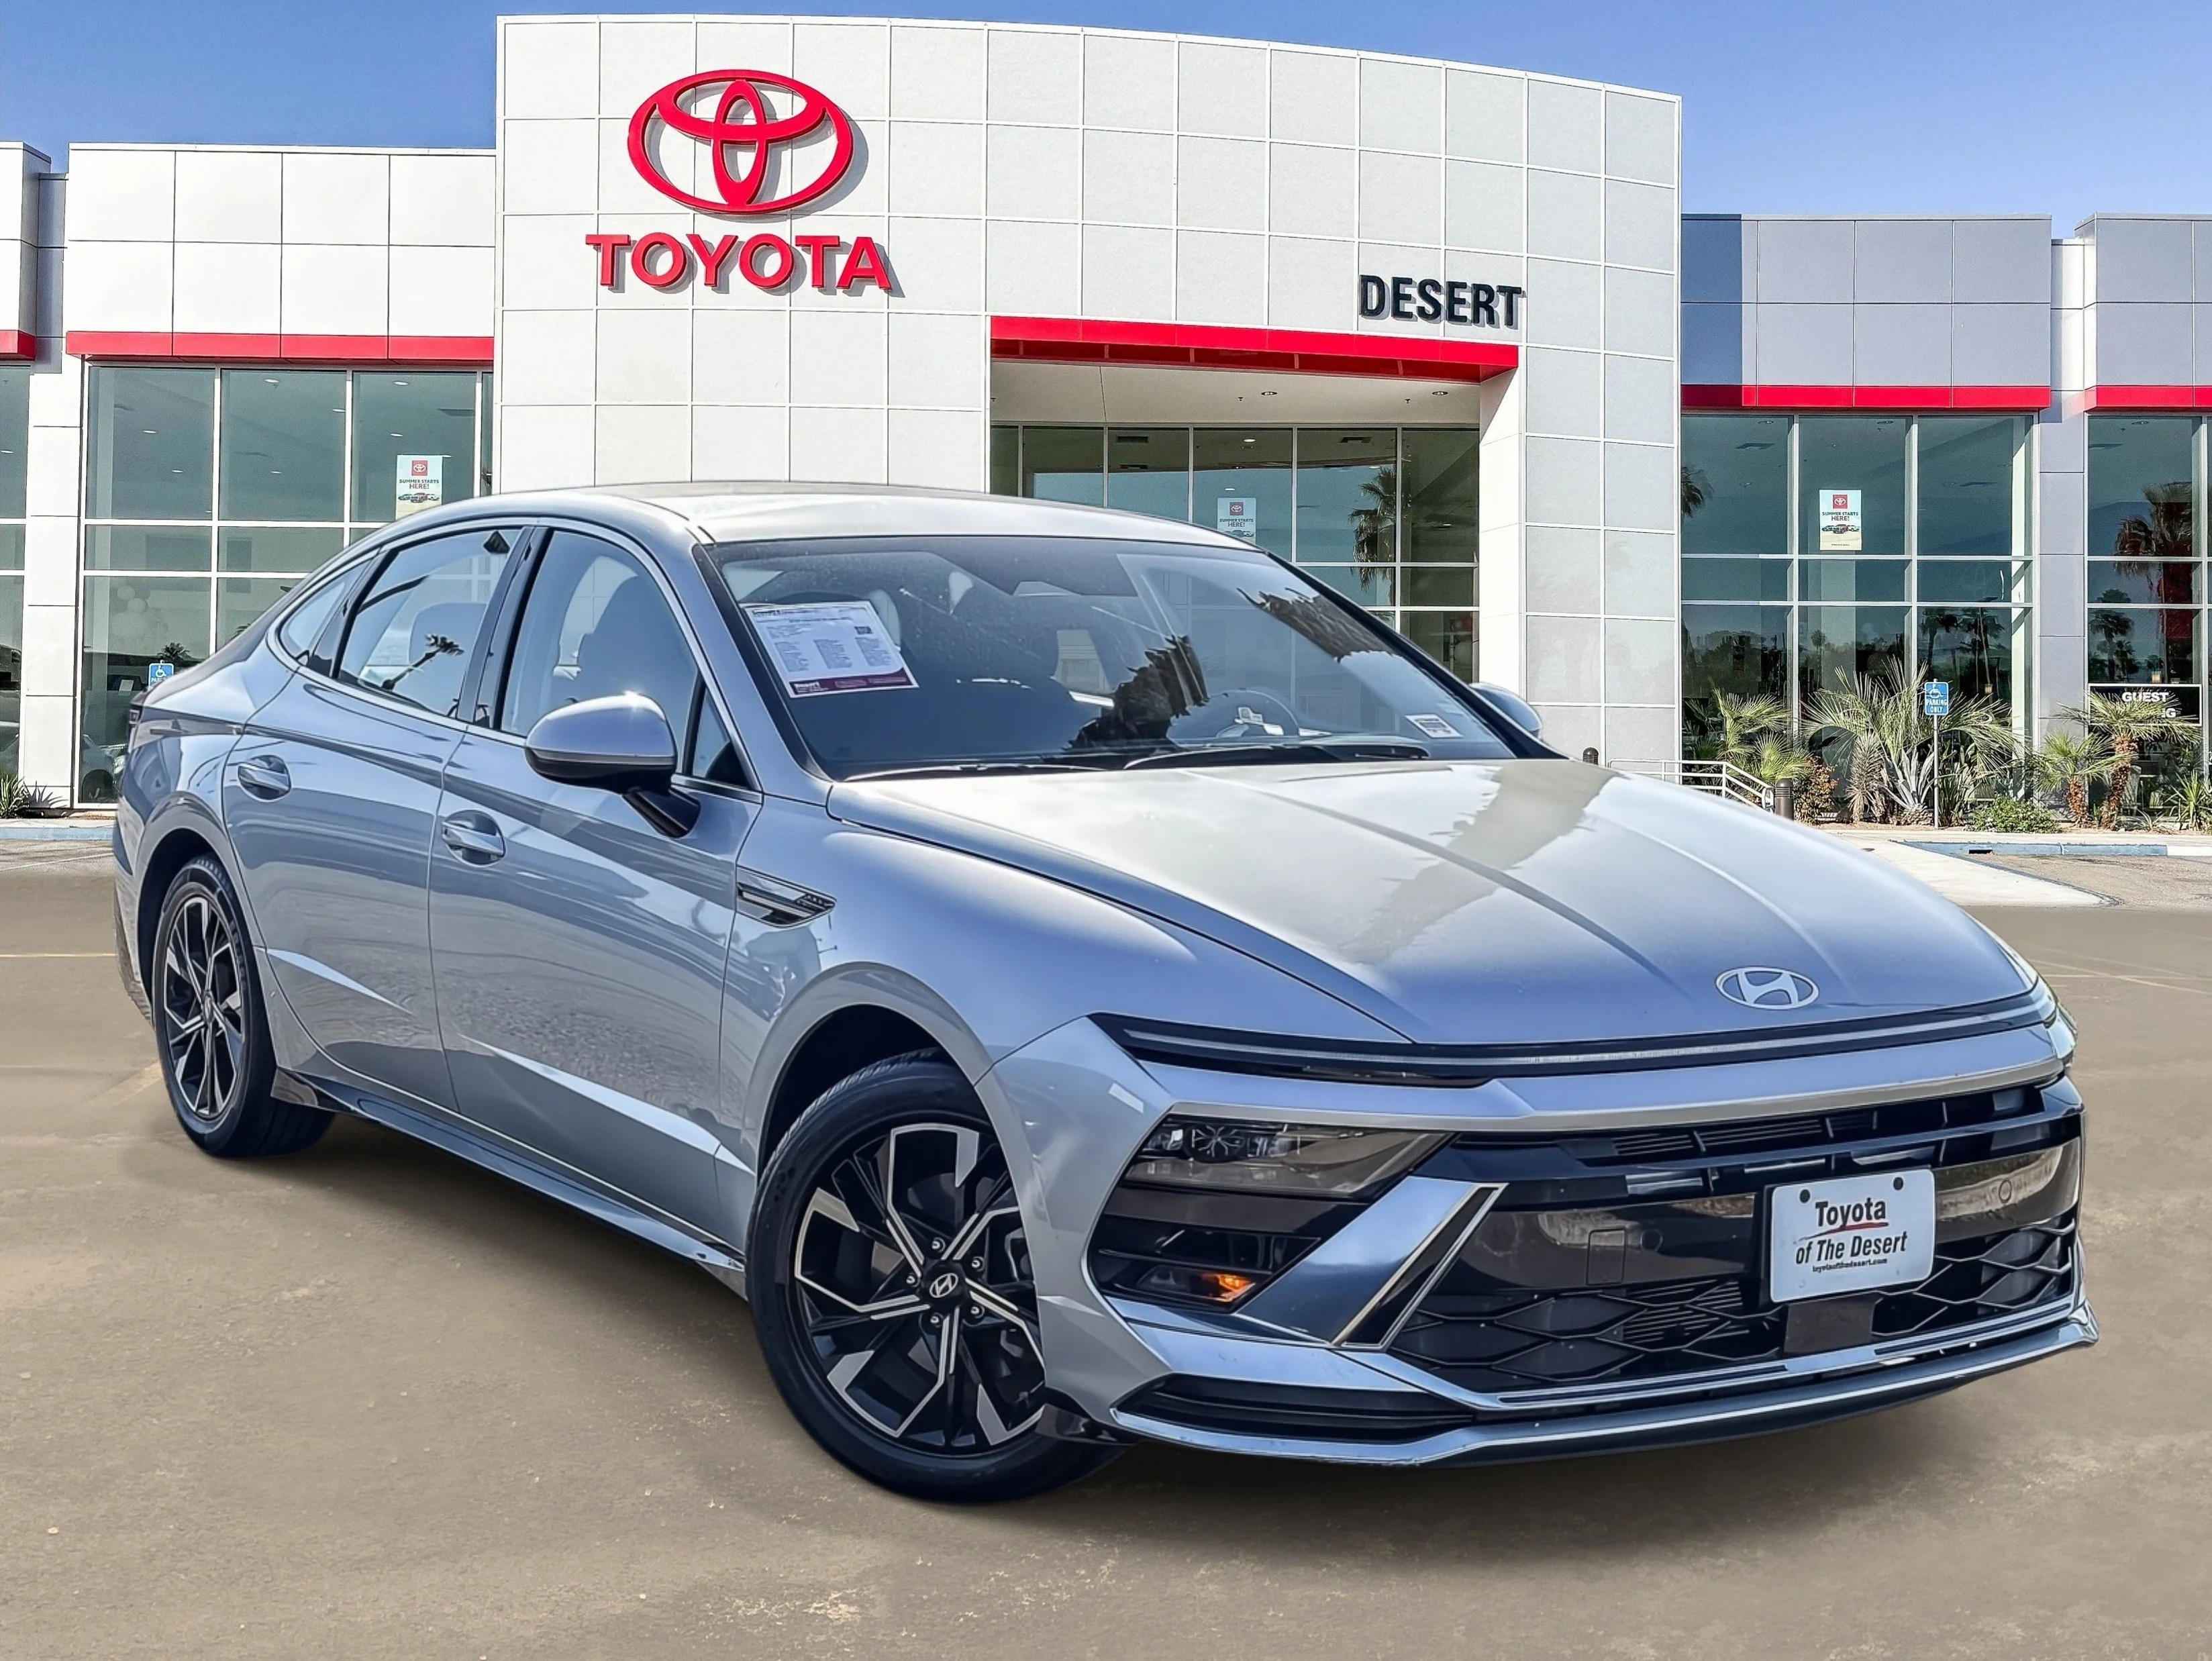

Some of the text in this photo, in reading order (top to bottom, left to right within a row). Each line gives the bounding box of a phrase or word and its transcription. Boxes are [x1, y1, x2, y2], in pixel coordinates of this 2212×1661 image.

[585, 232, 892, 291] TOYOTA
[1359, 274, 1522, 326] DESERT
[2121, 692, 2169, 703] GUEST
[1815, 1197, 1887, 1229] Toyota
[1796, 1230, 1907, 1264] of The Desert
